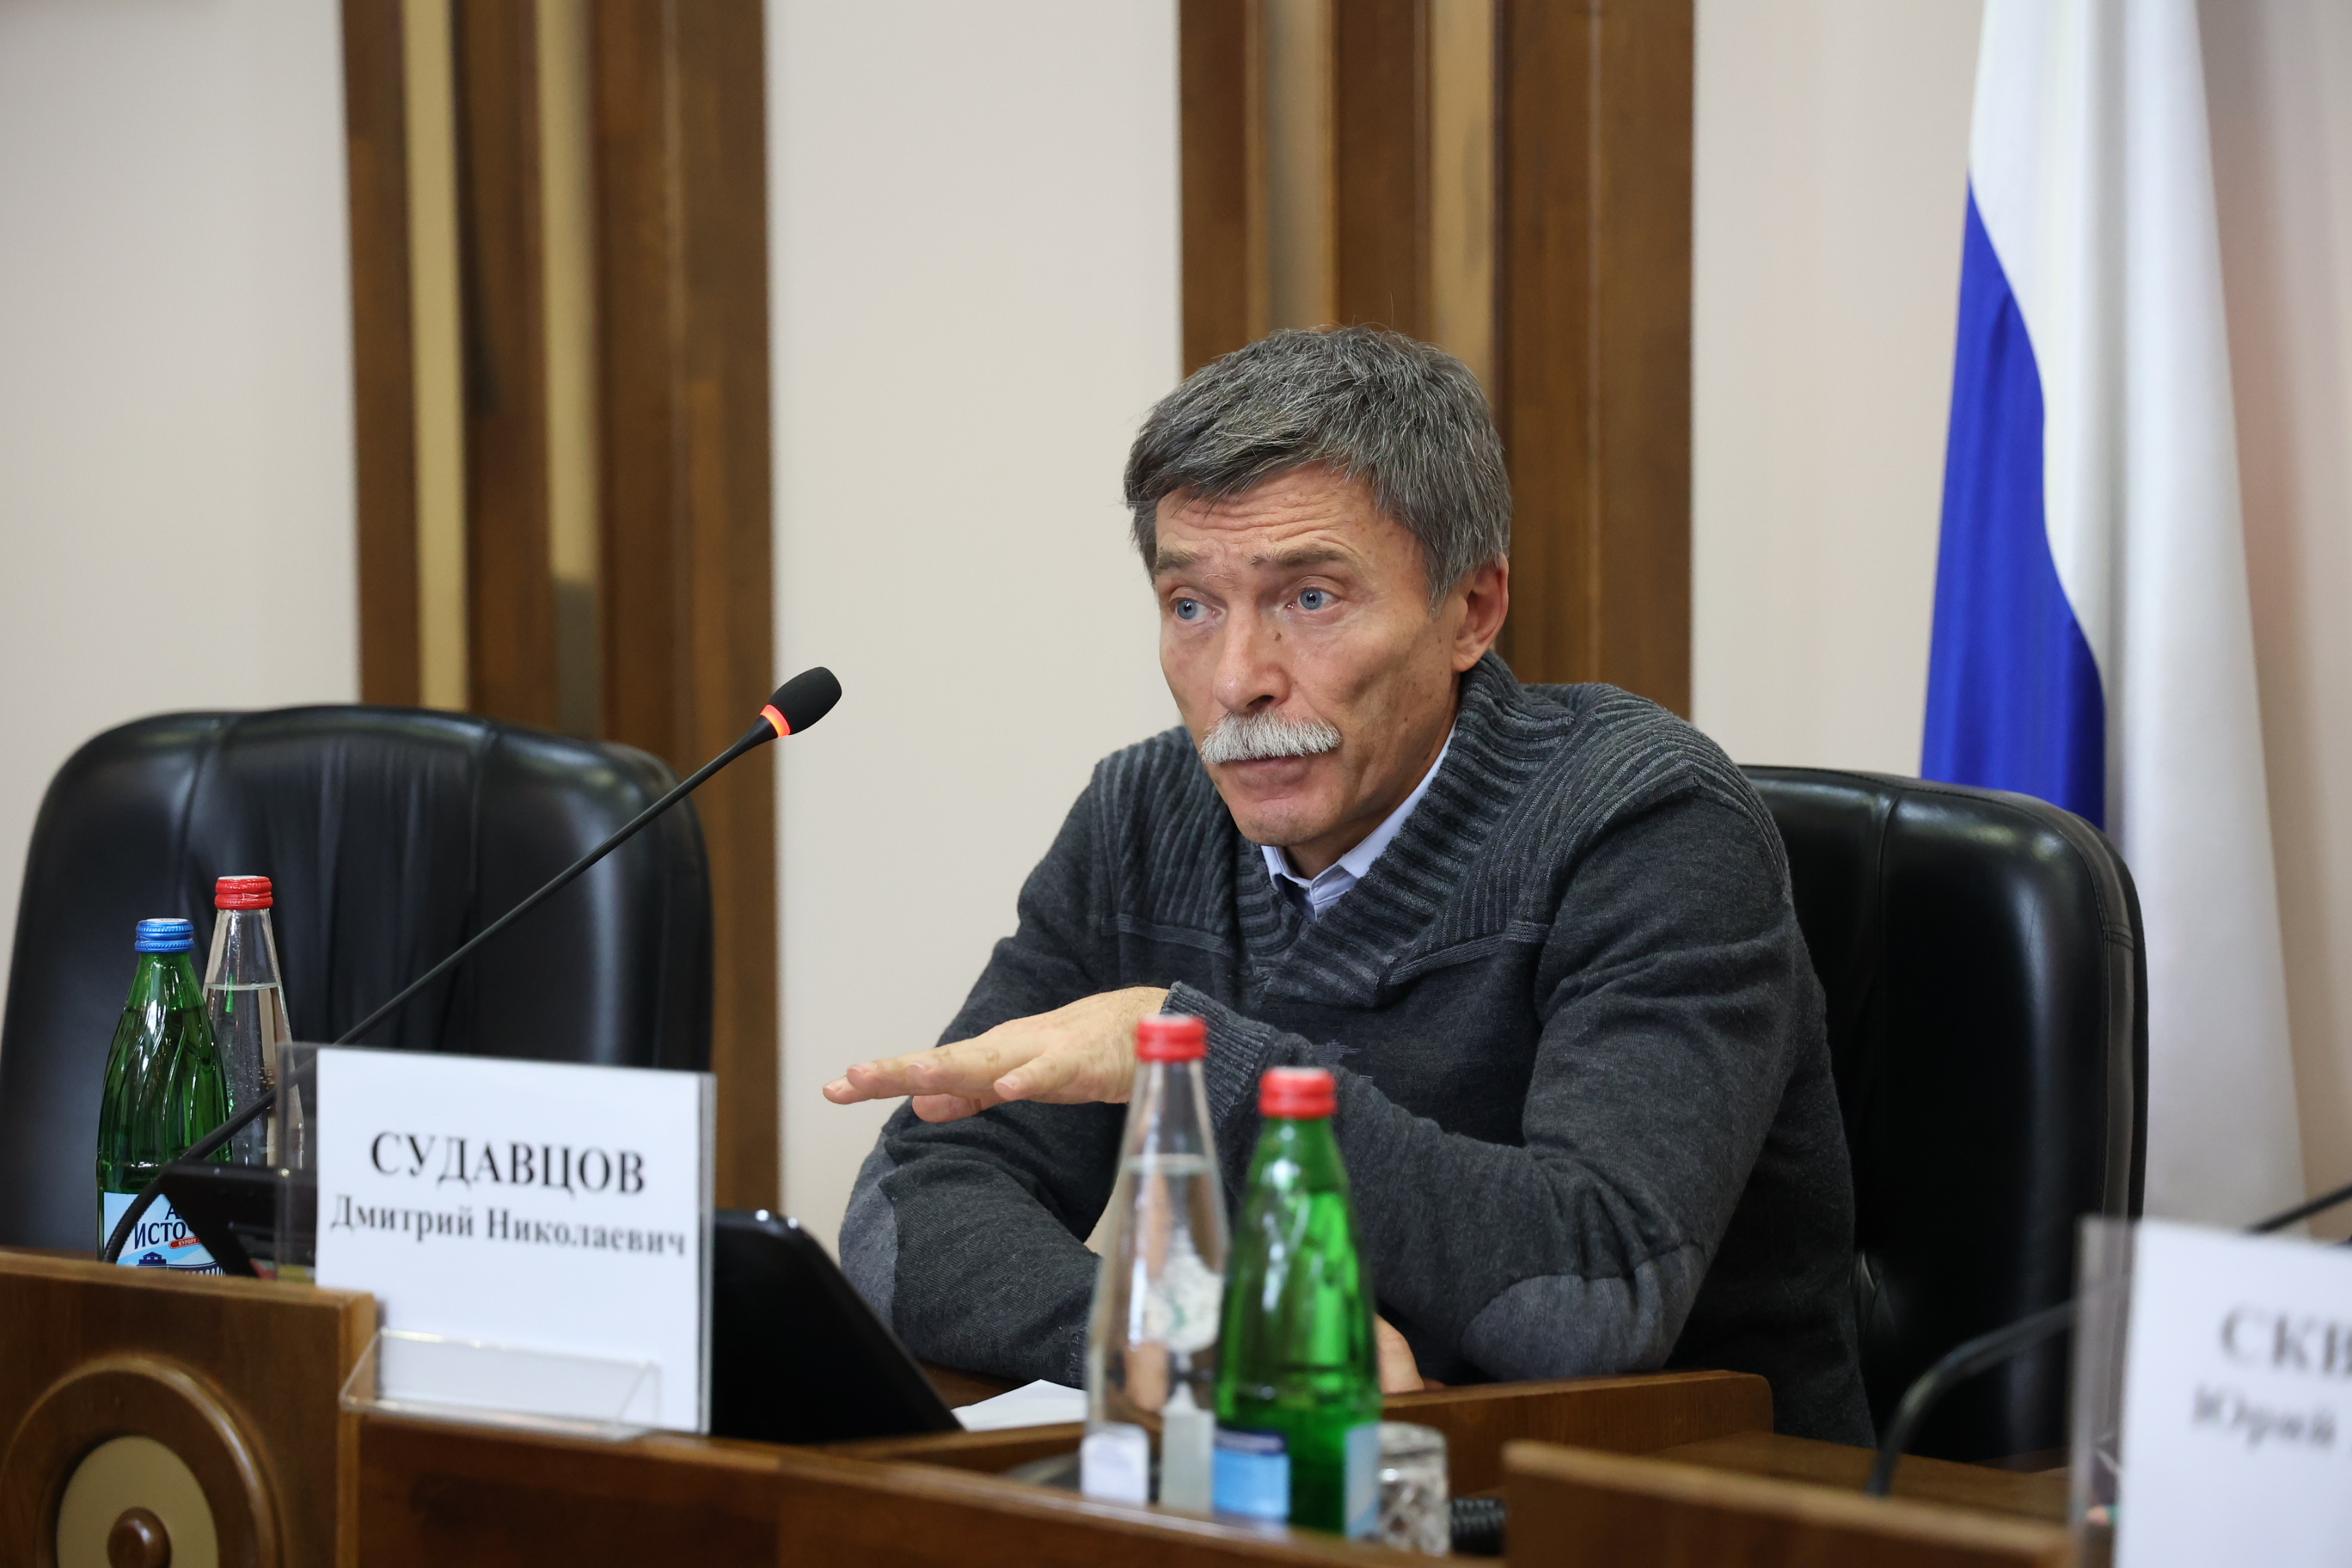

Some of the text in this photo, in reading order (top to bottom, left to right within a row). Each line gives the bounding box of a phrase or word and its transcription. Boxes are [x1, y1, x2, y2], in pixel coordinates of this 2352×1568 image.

[371, 1131, 646, 1197] СУДАВЦОВ
[330, 1195, 687, 1257] Дмитрий Николаевич
